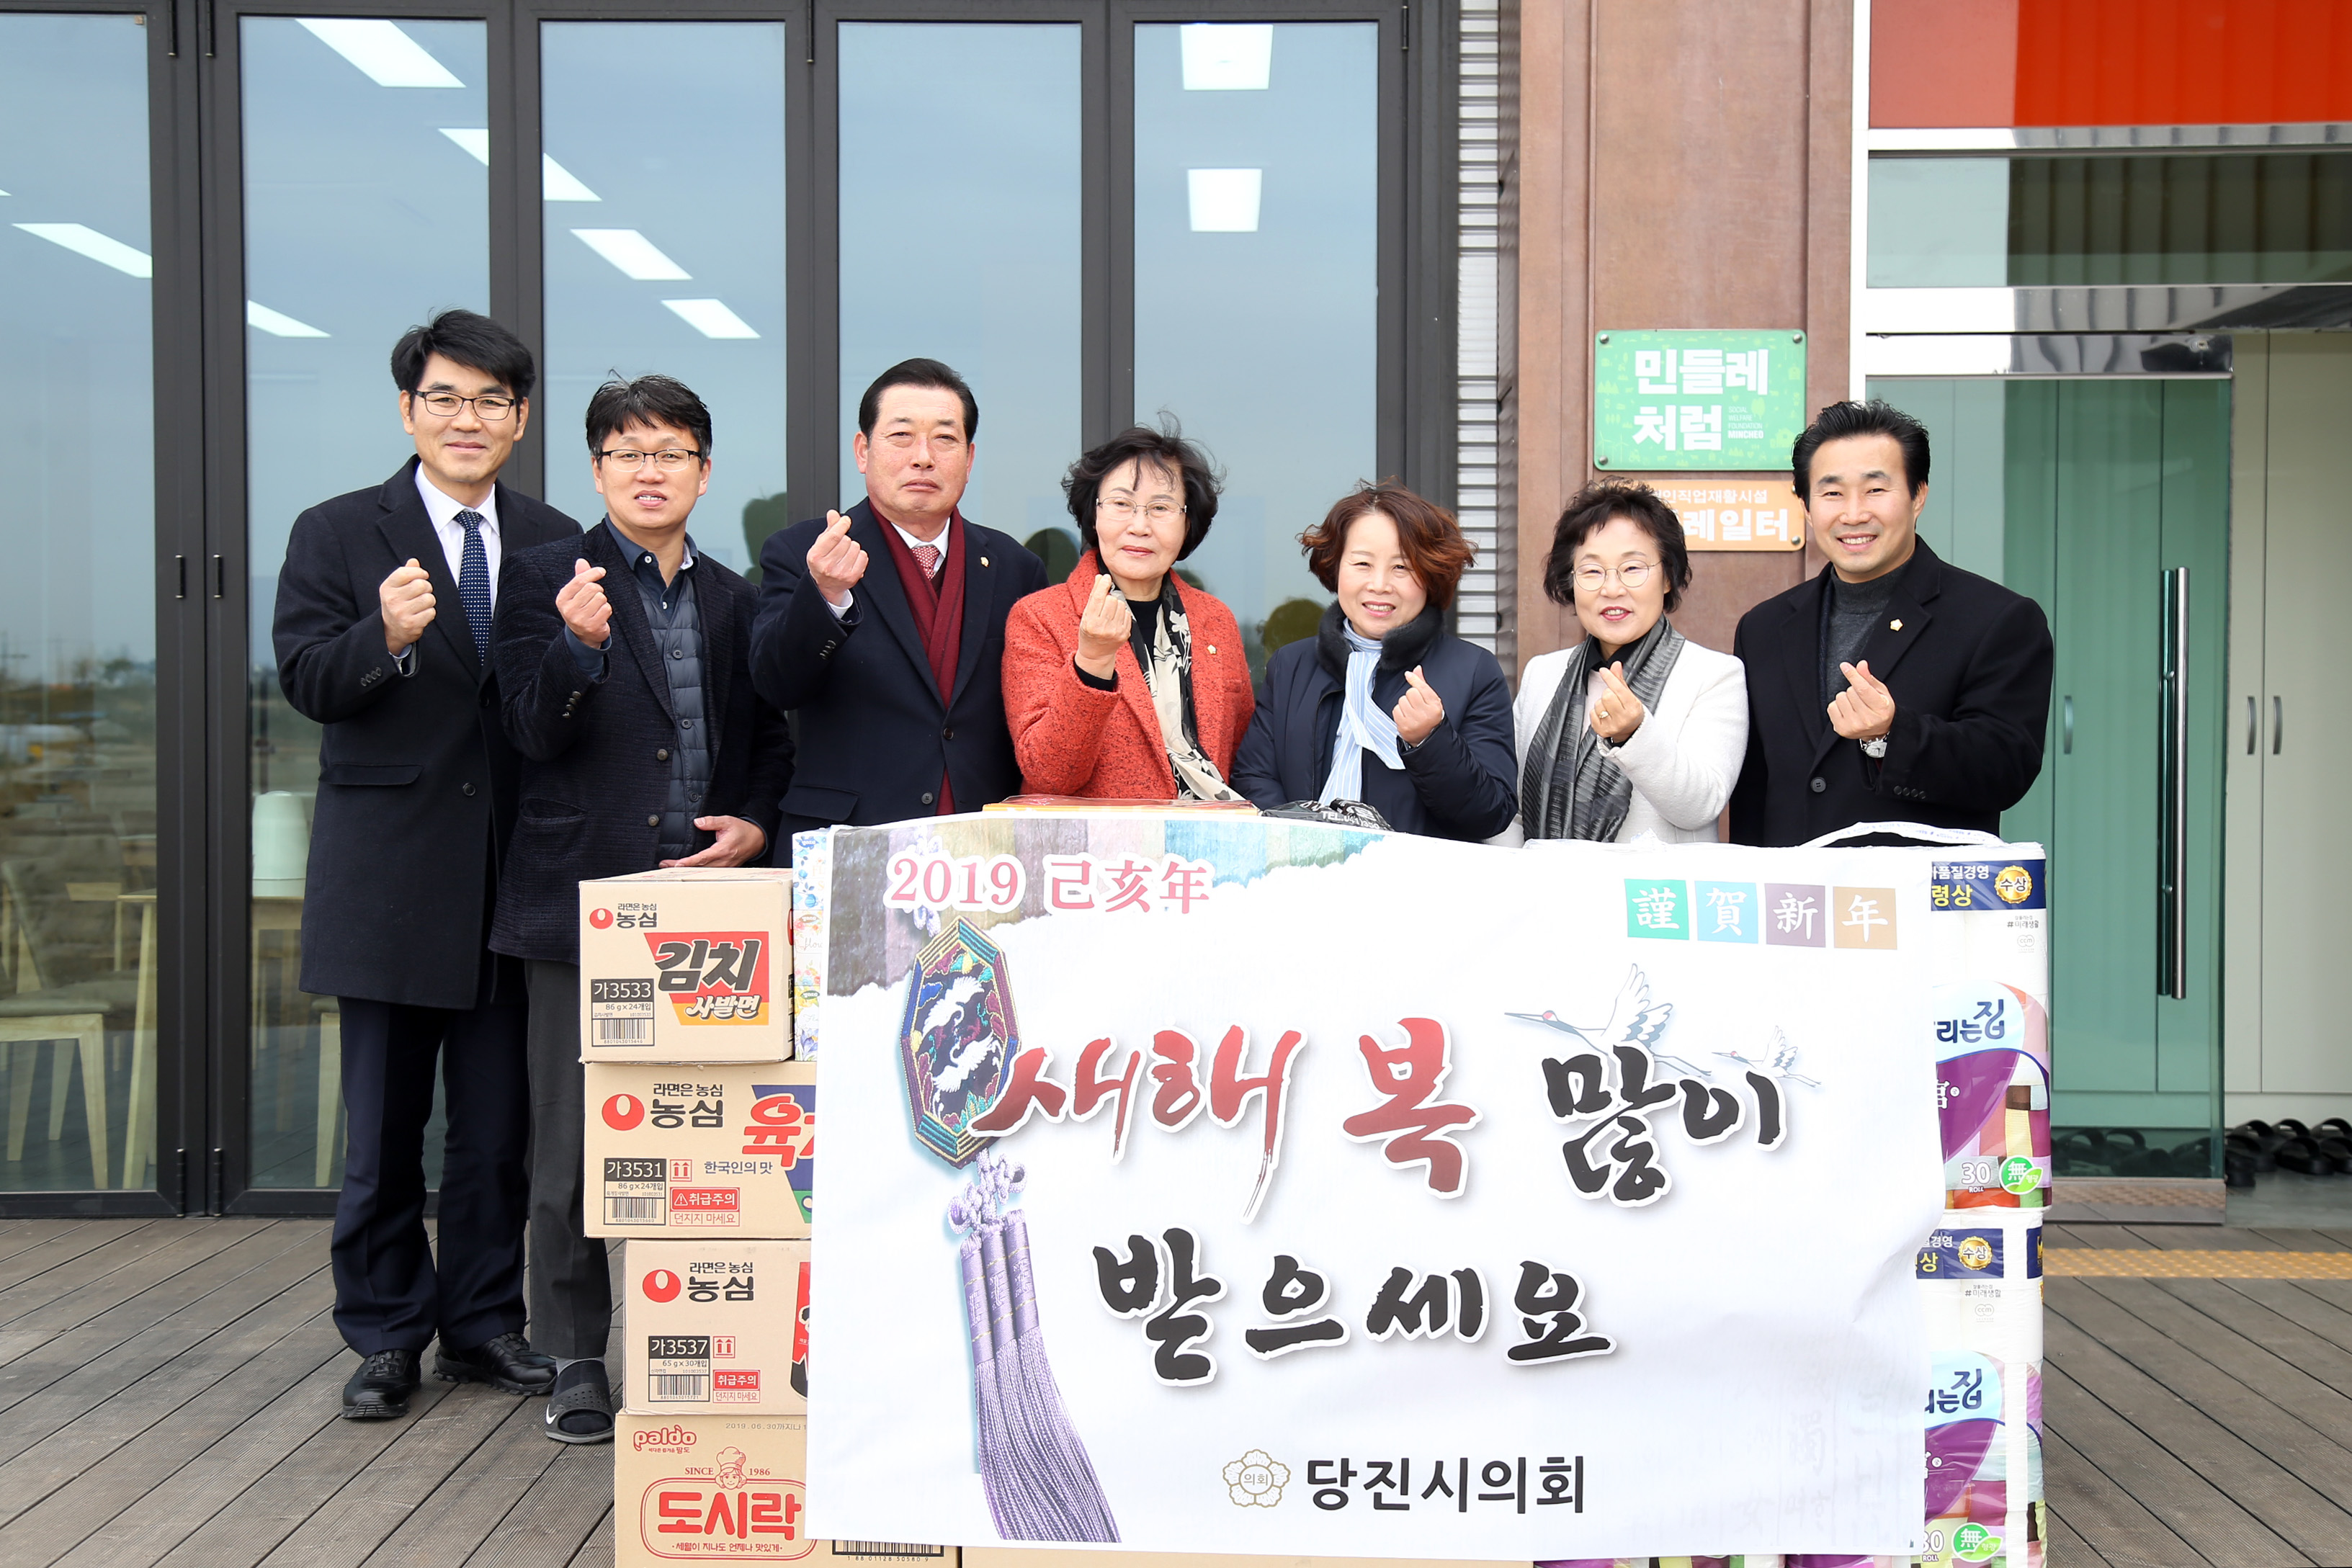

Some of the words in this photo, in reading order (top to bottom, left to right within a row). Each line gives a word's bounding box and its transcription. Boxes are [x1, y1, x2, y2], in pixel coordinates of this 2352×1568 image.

[1635, 349, 1769, 395] 민들레
[1632, 405, 1722, 451] 처럼
[1728, 430, 1764, 439] MINCHEO
[1679, 509, 1789, 542] 레일터
[891, 857, 1019, 905] 2019
[1050, 860, 1209, 914] 己亥年
[2000, 877, 2027, 892] 수상
[1932, 884, 1973, 907] 령상
[617, 902, 640, 911] 라면은
[641, 902, 657, 911] 농심
[617, 912, 657, 928] 농심
[655, 938, 762, 993] 김치
[594, 982, 652, 1000] 가3533
[685, 995, 762, 1020] 사발면
[1935, 999, 2005, 1044] 리는집
[653, 1083, 694, 1097] 라면은
[695, 1083, 723, 1097] 농심
[650, 1099, 723, 1129] 농심
[972, 1023, 1302, 1219] 새해
[1343, 1016, 1480, 1196] 복
[1540, 1044, 1784, 1206] 많이
[607, 1161, 663, 1178] 가3531
[704, 1160, 757, 1175] 한국인의
[760, 1160, 773, 1175] 맛
[1962, 1162, 1991, 1185] 30
[2007, 1161, 2027, 1181] 無
[689, 1193, 735, 1206] 취급주의
[674, 1213, 705, 1224] 던지지
[706, 1213, 736, 1224] 마세요
[1962, 1246, 1987, 1260] 수상
[689, 1261, 726, 1274] 라면은
[728, 1261, 754, 1274] 농심
[1917, 1252, 1939, 1273] 상
[687, 1276, 754, 1302] 농심
[1964, 1289, 2001, 1298] #미래생활
[1093, 1227, 1616, 1386] 받으세요
[651, 1338, 708, 1356] 가3537
[717, 1375, 756, 1386] 취급주의
[715, 1392, 735, 1402] 던지지
[737, 1392, 758, 1402] 마세요
[633, 1425, 697, 1451] paldo
[684, 1467, 714, 1476] SINCE
[748, 1467, 771, 1476] 1986
[1243, 1473, 1269, 1487] 의회
[1307, 1456, 1584, 1514] 당진시의회
[658, 1491, 802, 1541] 도시락
[702, 1542, 726, 1551] 지나도
[729, 1543, 753, 1552] 언제나
[1959, 1528, 1982, 1548] 無
[1981, 1542, 1997, 1551] 형광
